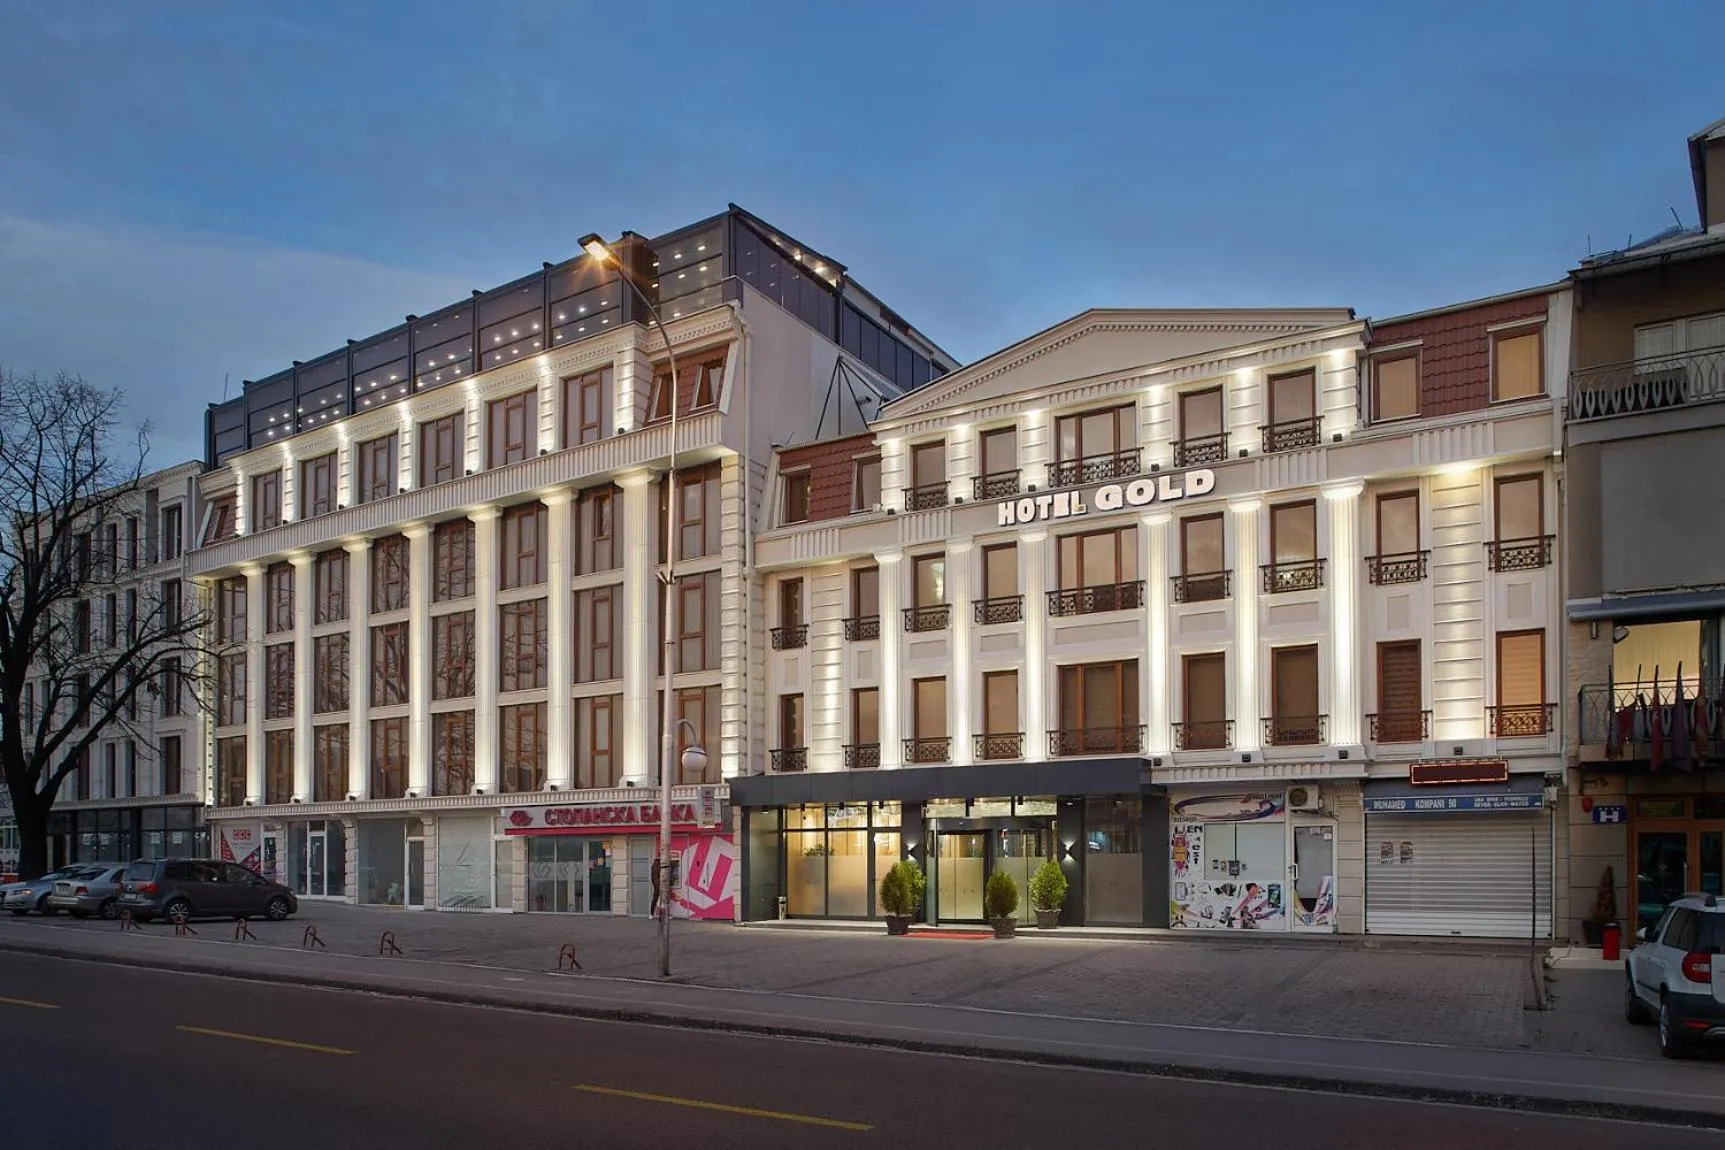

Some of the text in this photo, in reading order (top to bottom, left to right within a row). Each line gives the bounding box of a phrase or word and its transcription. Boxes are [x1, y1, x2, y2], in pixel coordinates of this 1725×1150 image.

[997, 469, 1216, 527] HOTEL GOLD
[544, 806, 637, 826] СТОПАНСКА
[640, 803, 696, 822] БАКА
[1599, 810, 1619, 822] H
